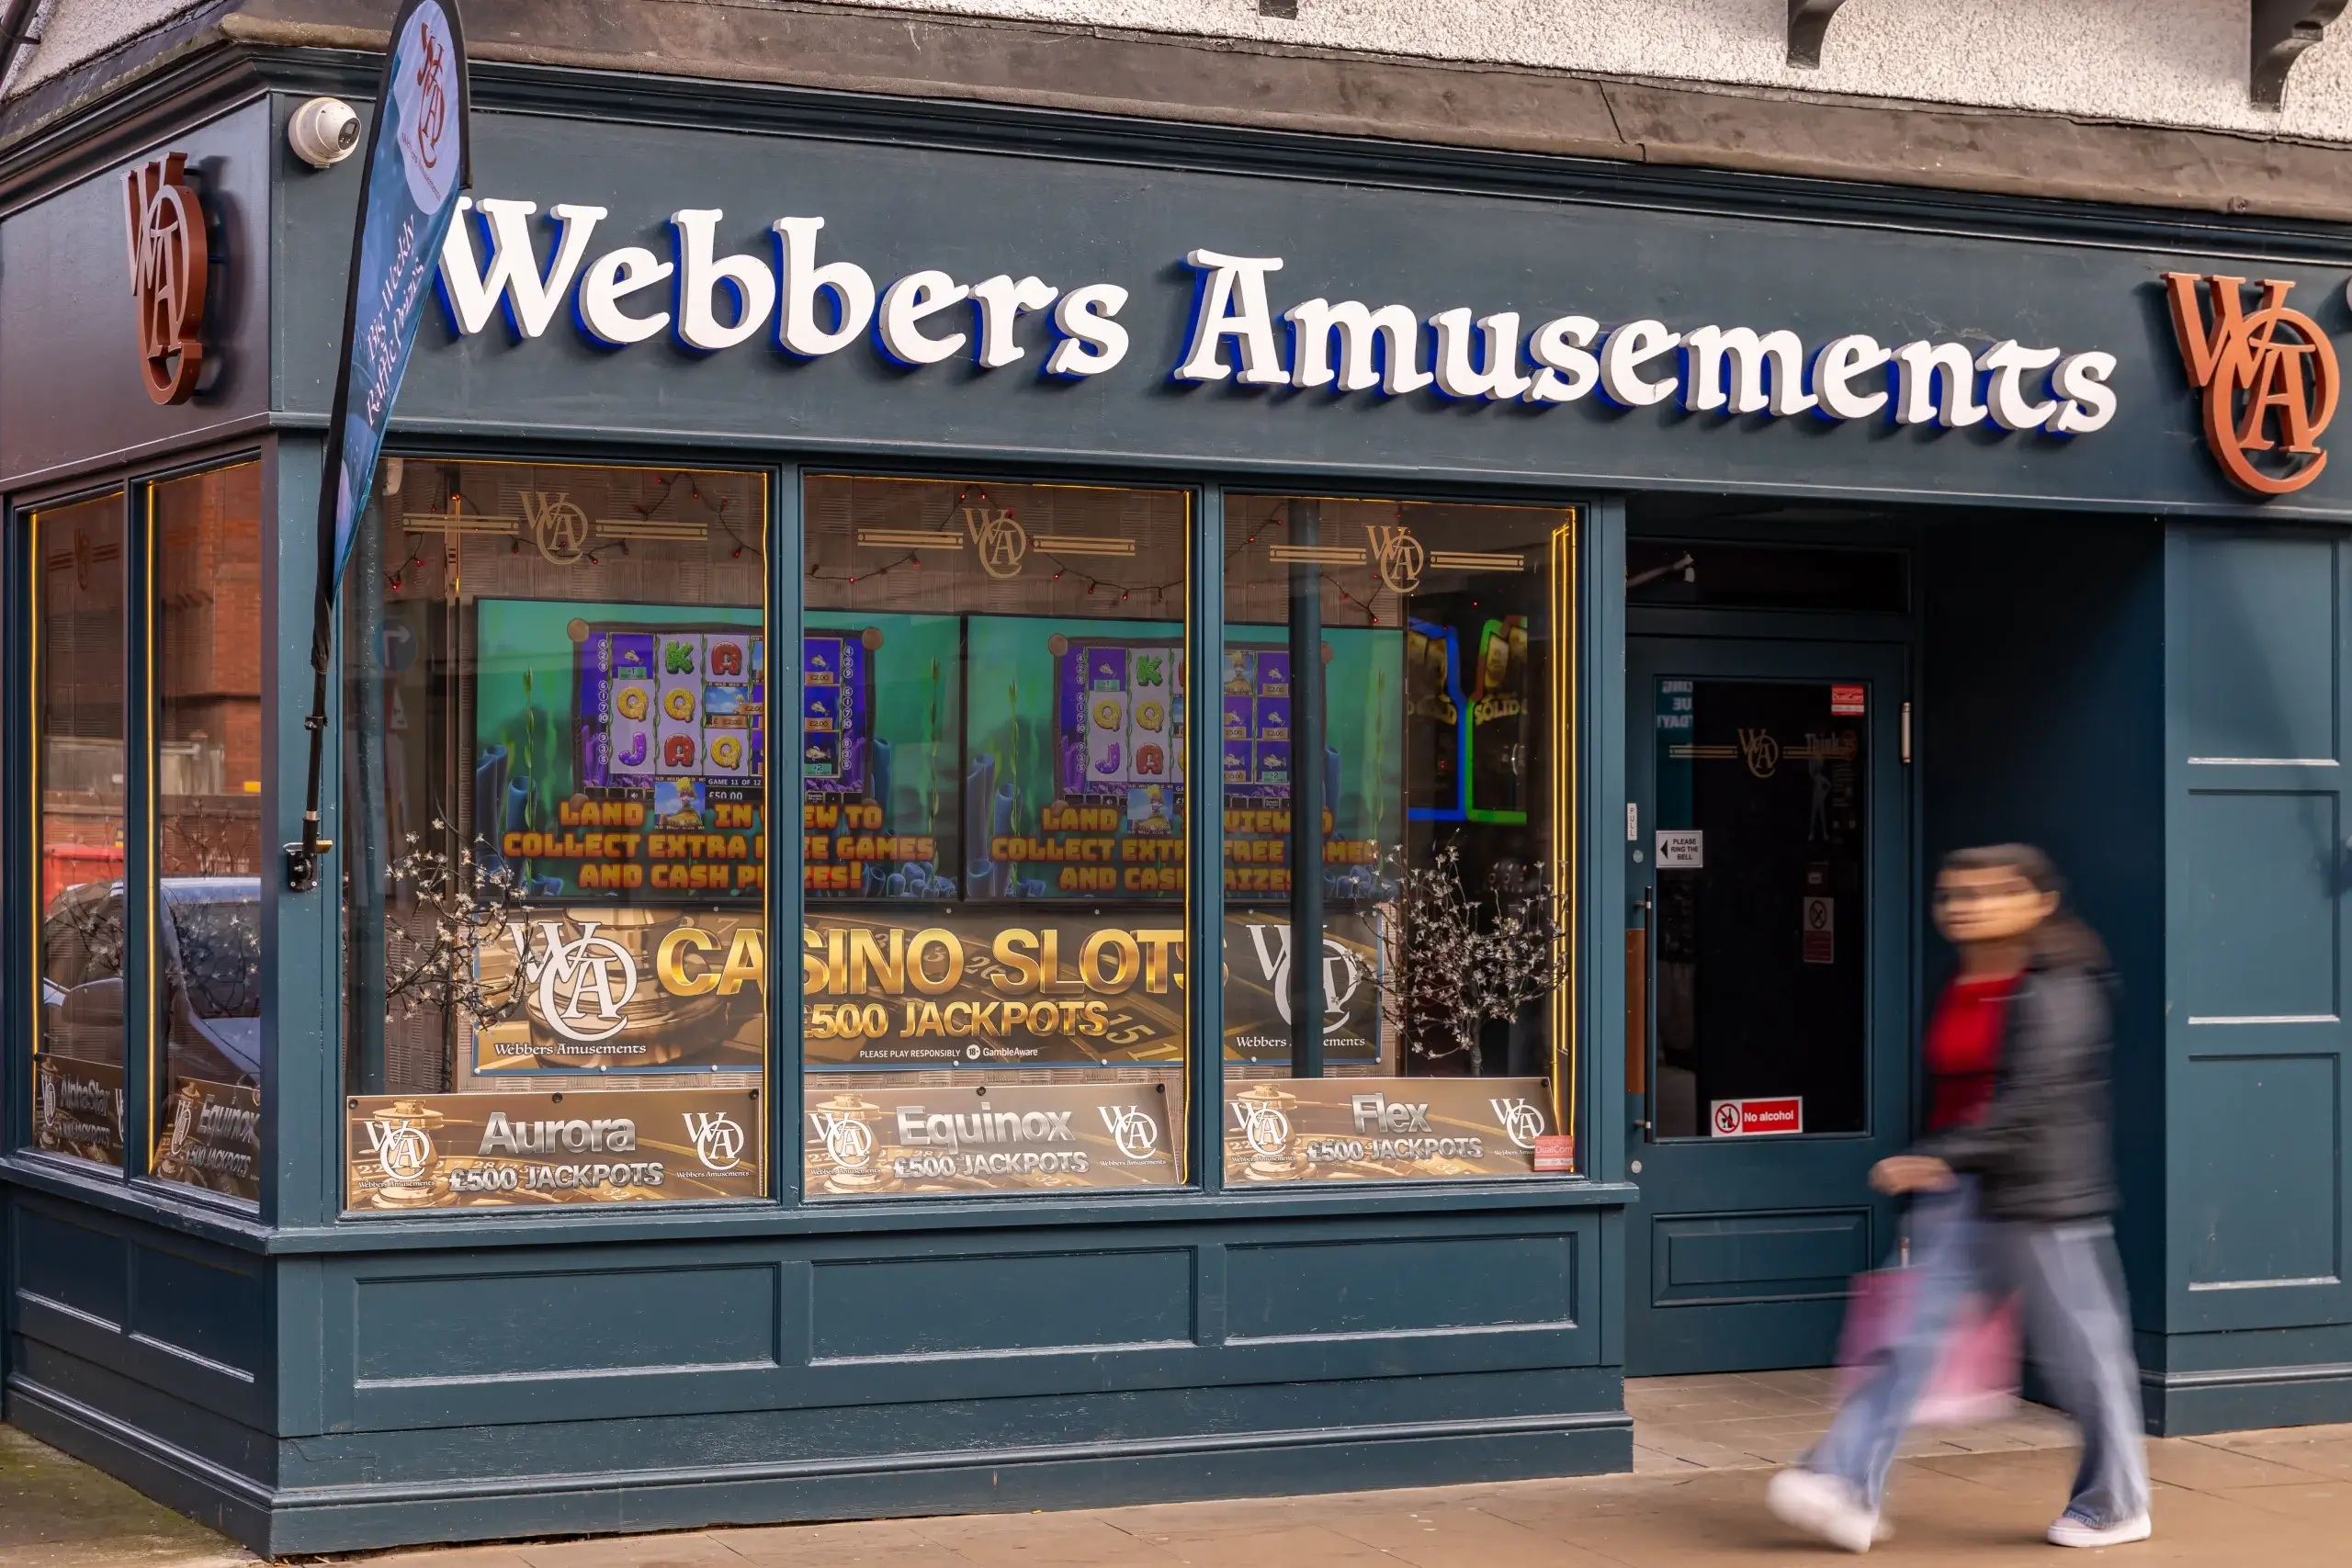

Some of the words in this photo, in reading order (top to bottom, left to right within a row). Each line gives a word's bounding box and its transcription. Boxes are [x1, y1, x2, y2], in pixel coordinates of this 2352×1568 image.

[435, 194, 1130, 375] Webbers
[1173, 247, 2119, 435] Amusements
[664, 639, 695, 675] K
[711, 641, 742, 676] A
[1136, 655, 1163, 687] K
[616, 686, 649, 723] Q
[664, 687, 695, 723] Q
[1093, 699, 1122, 732] Q
[1136, 700, 1164, 733] Q
[618, 732, 647, 766] J
[664, 733, 695, 768] A
[710, 735, 742, 771] Q
[1094, 742, 1120, 774] J
[560, 802, 643, 826] LAND
[714, 804, 753, 828] IN
[844, 806, 884, 830] TO
[1042, 807, 1120, 832] LAND
[504, 832, 641, 857] COLLECT
[648, 834, 749, 858] EXTRA
[836, 837, 935, 861] GAMES
[989, 836, 1117, 862] COLLECT
[579, 863, 642, 888] AND
[650, 865, 730, 889] CASH
[1058, 866, 1118, 891] AND
[899, 1000, 1111, 1038] JACKPOTS
[494, 1043, 553, 1055] Webbers
[556, 1043, 647, 1055] Amusements
[859, 1050, 888, 1058] PLEASE
[889, 1050, 910, 1058] PLAY
[910, 1048, 961, 1057] RESPONSIBLY
[1236, 1035, 1286, 1048] Webbers
[197, 1093, 261, 1147] Equinox
[896, 1101, 1078, 1156] Equinox
[1351, 1092, 1433, 1135] Flex
[1744, 1111, 1758, 1122] No
[1759, 1110, 1793, 1122] alcohol
[478, 1111, 636, 1156] Aurora
[892, 1156, 956, 1179] £500
[963, 1151, 1090, 1176] JACKPOTS
[1306, 1140, 1364, 1163] £500
[1371, 1137, 1485, 1161] JACKPOTS
[358, 1180, 389, 1189] Webbers
[389, 1179, 436, 1189] Amusements
[448, 1167, 518, 1192] £500
[525, 1162, 665, 1190] JACKPOTS
